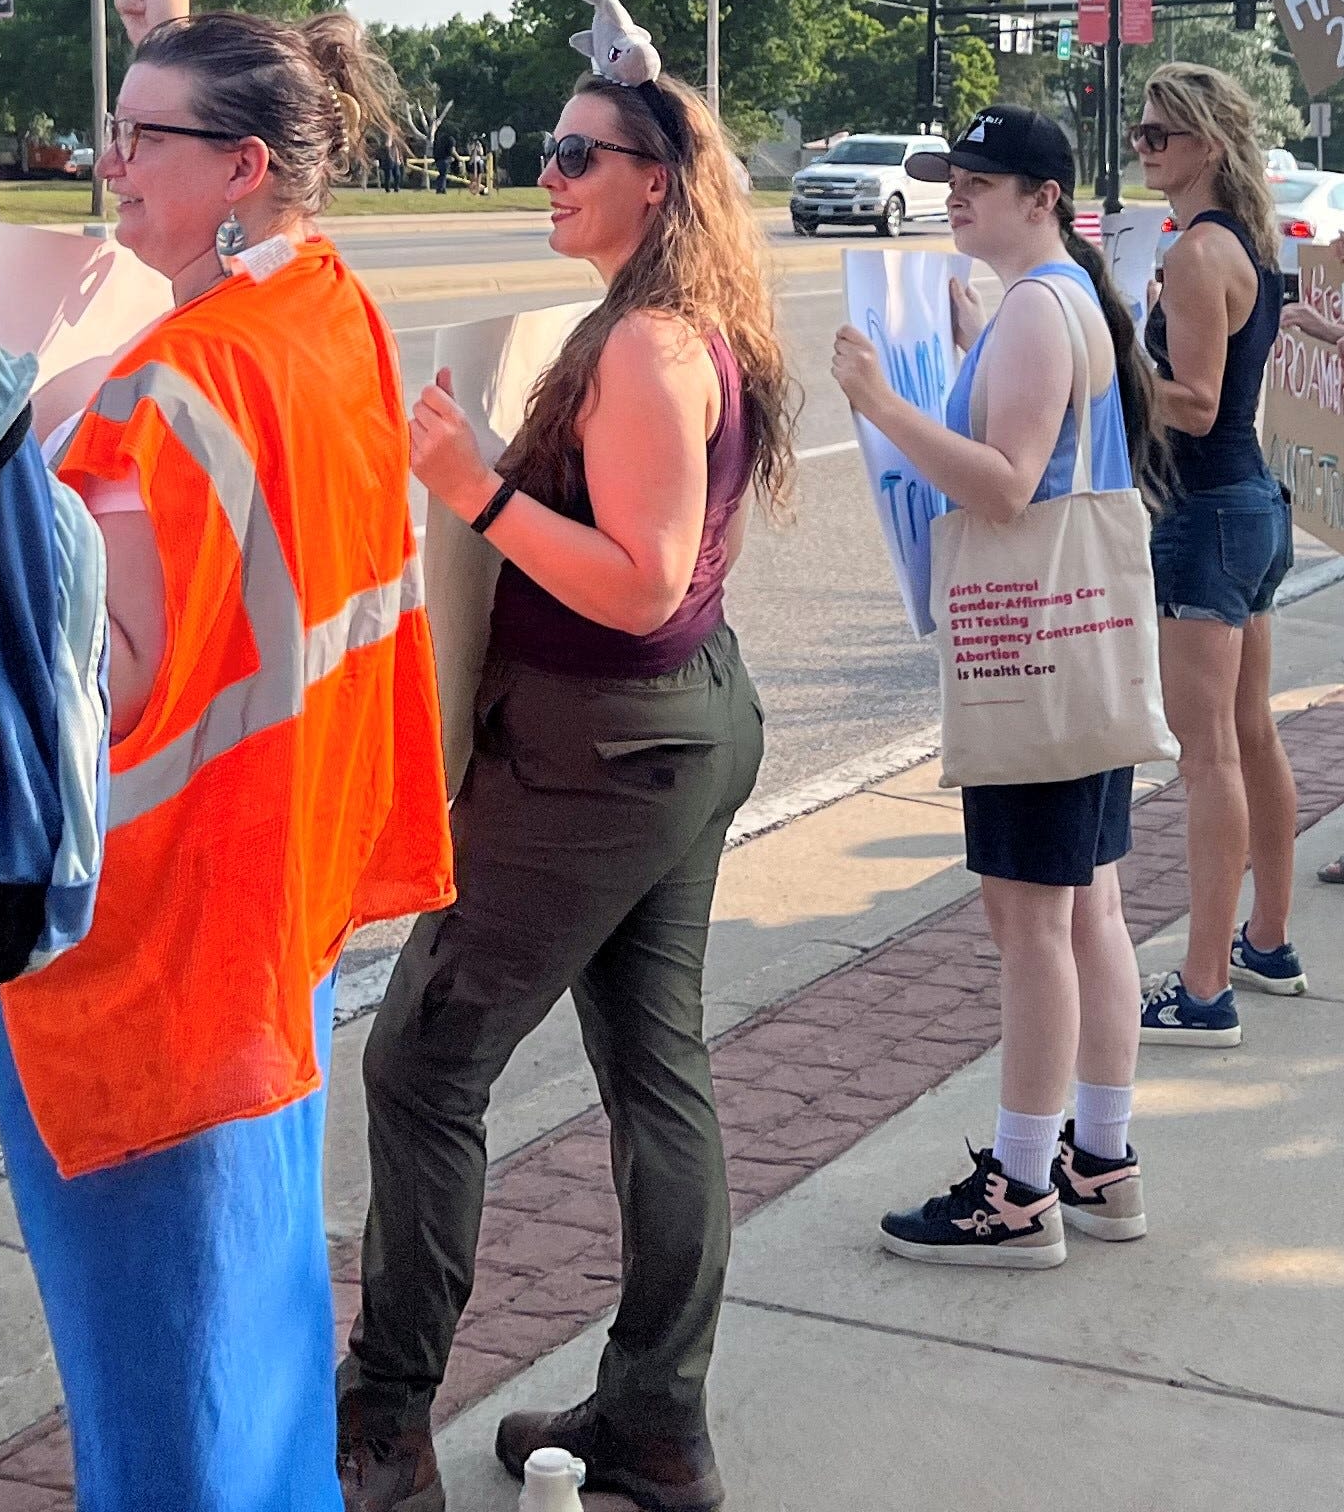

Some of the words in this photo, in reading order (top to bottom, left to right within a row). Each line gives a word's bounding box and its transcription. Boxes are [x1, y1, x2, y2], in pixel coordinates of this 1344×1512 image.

[1270, 331, 1307, 400] PRO
[985, 578, 1039, 594] Control
[949, 592, 1073, 614] Gender-Affirming
[1076, 587, 1106, 600] Care
[951, 618, 973, 630] STI
[976, 614, 1029, 629] Testing
[953, 632, 1032, 647] Emergency
[1036, 615, 1134, 641] Contraception
[955, 648, 1020, 664] Abortion
[973, 664, 1021, 680] Health
[1024, 663, 1056, 676] Care
